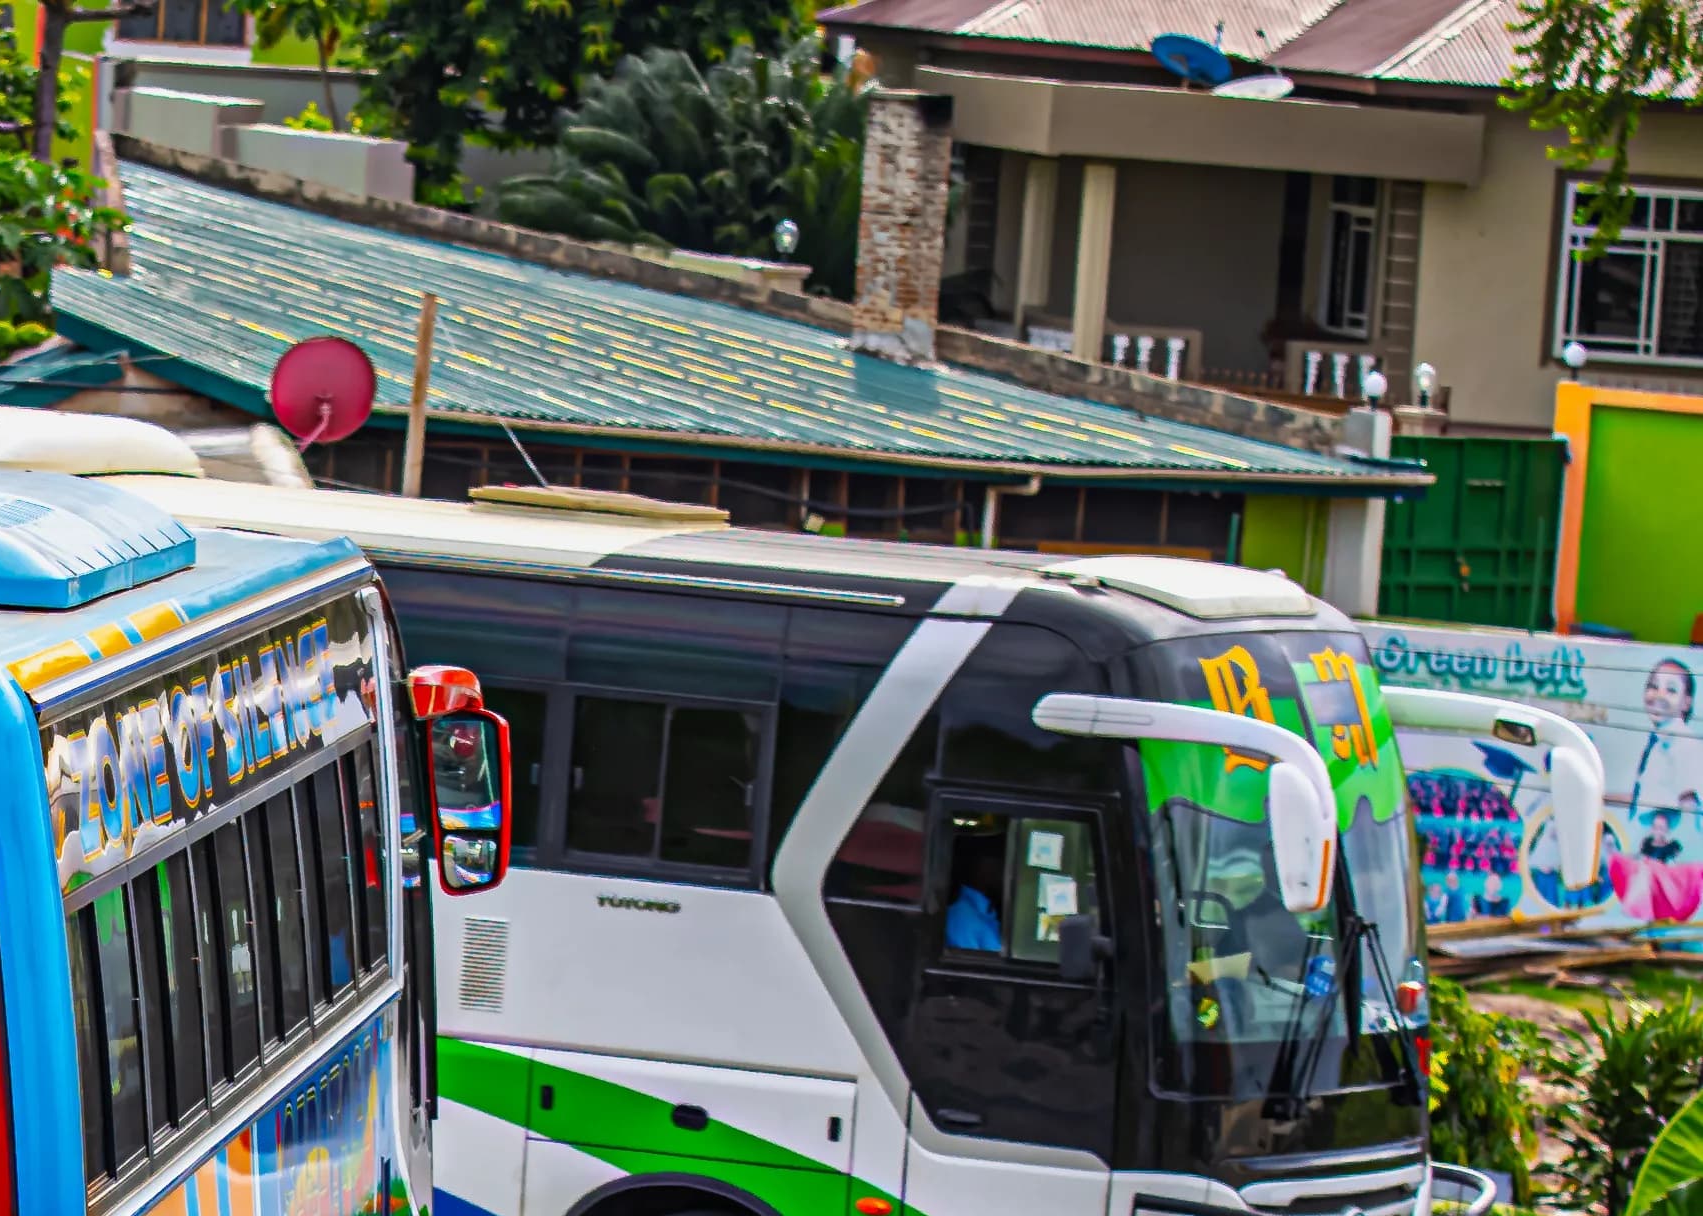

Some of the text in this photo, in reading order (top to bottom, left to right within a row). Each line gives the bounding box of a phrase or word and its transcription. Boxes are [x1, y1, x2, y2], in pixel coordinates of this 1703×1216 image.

[1375, 630, 1498, 681] Green
[1505, 640, 1586, 690] belt
[66, 698, 173, 864] ZONE
[169, 675, 216, 809] OF
